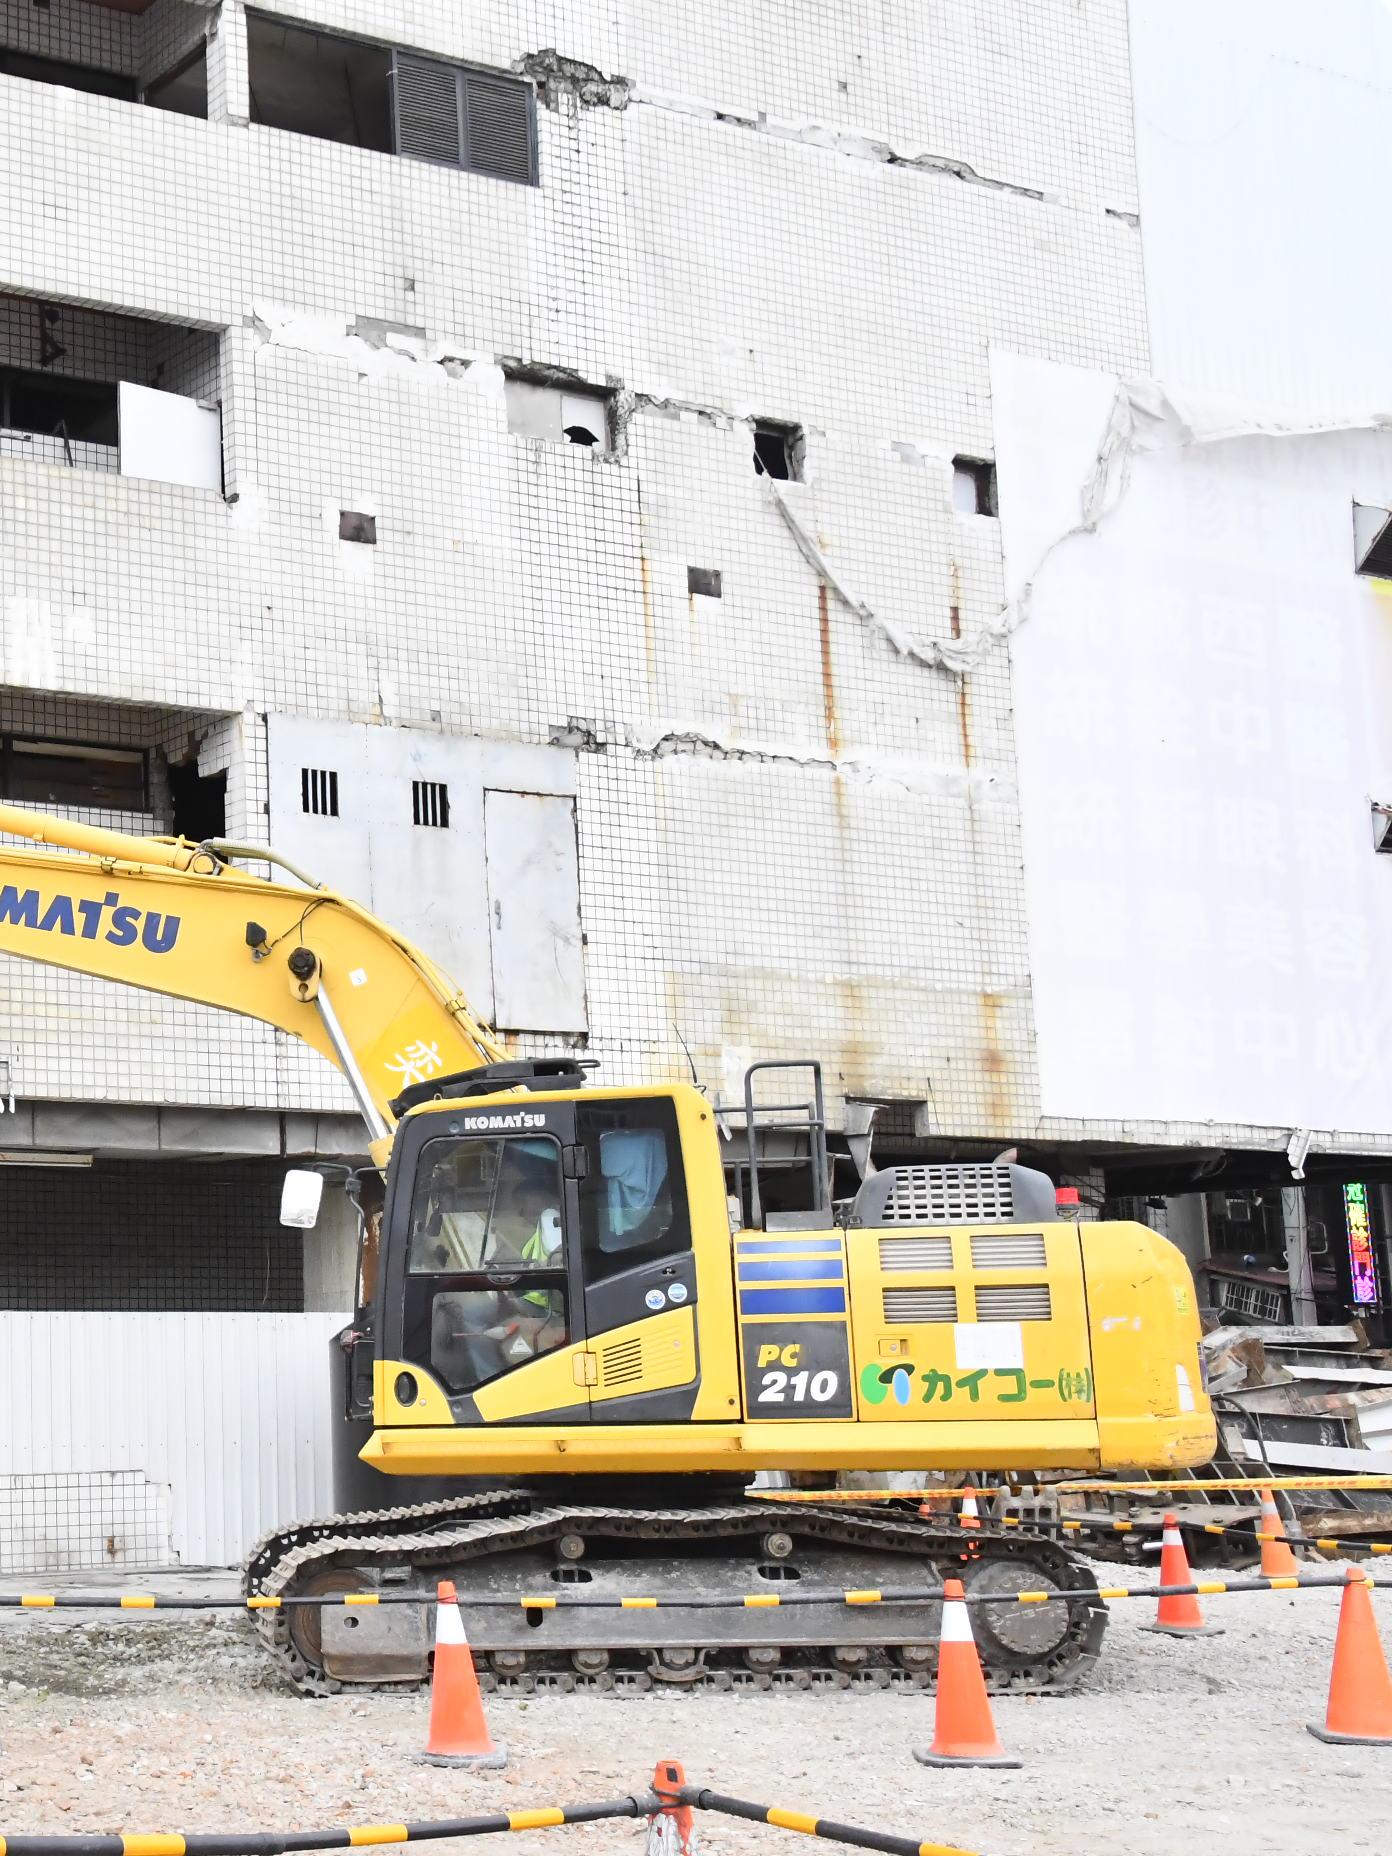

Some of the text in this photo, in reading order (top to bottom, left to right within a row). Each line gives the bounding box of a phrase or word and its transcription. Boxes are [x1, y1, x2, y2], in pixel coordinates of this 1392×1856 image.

[465, 1112, 545, 1129] KOMATSU
[757, 1344, 800, 1368] PC
[758, 1370, 838, 1402] 210
